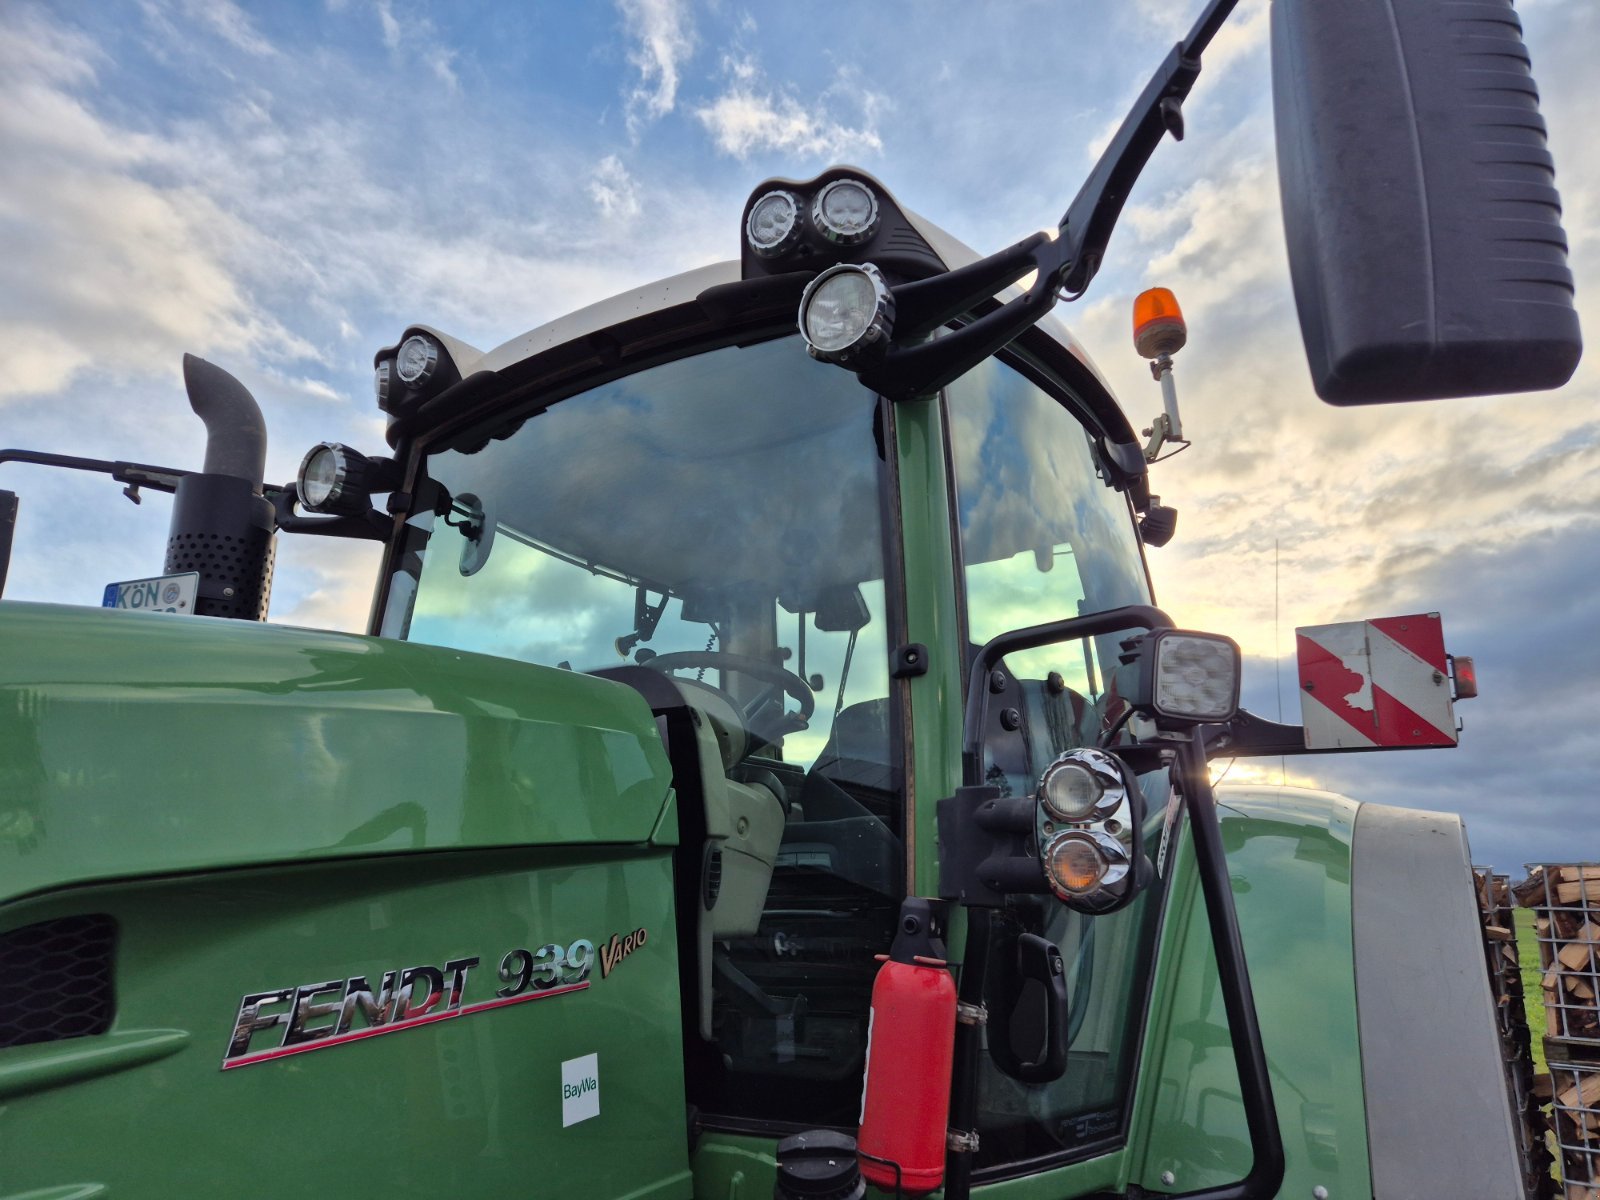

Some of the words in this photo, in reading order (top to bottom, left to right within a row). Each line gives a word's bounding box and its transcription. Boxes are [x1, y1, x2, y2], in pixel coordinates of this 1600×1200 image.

[116, 581, 161, 609] KÖN
[226, 957, 480, 1059] FENDT
[496, 938, 595, 998] 939
[600, 927, 648, 979] VARIO
[563, 1077, 597, 1099] BayWa
